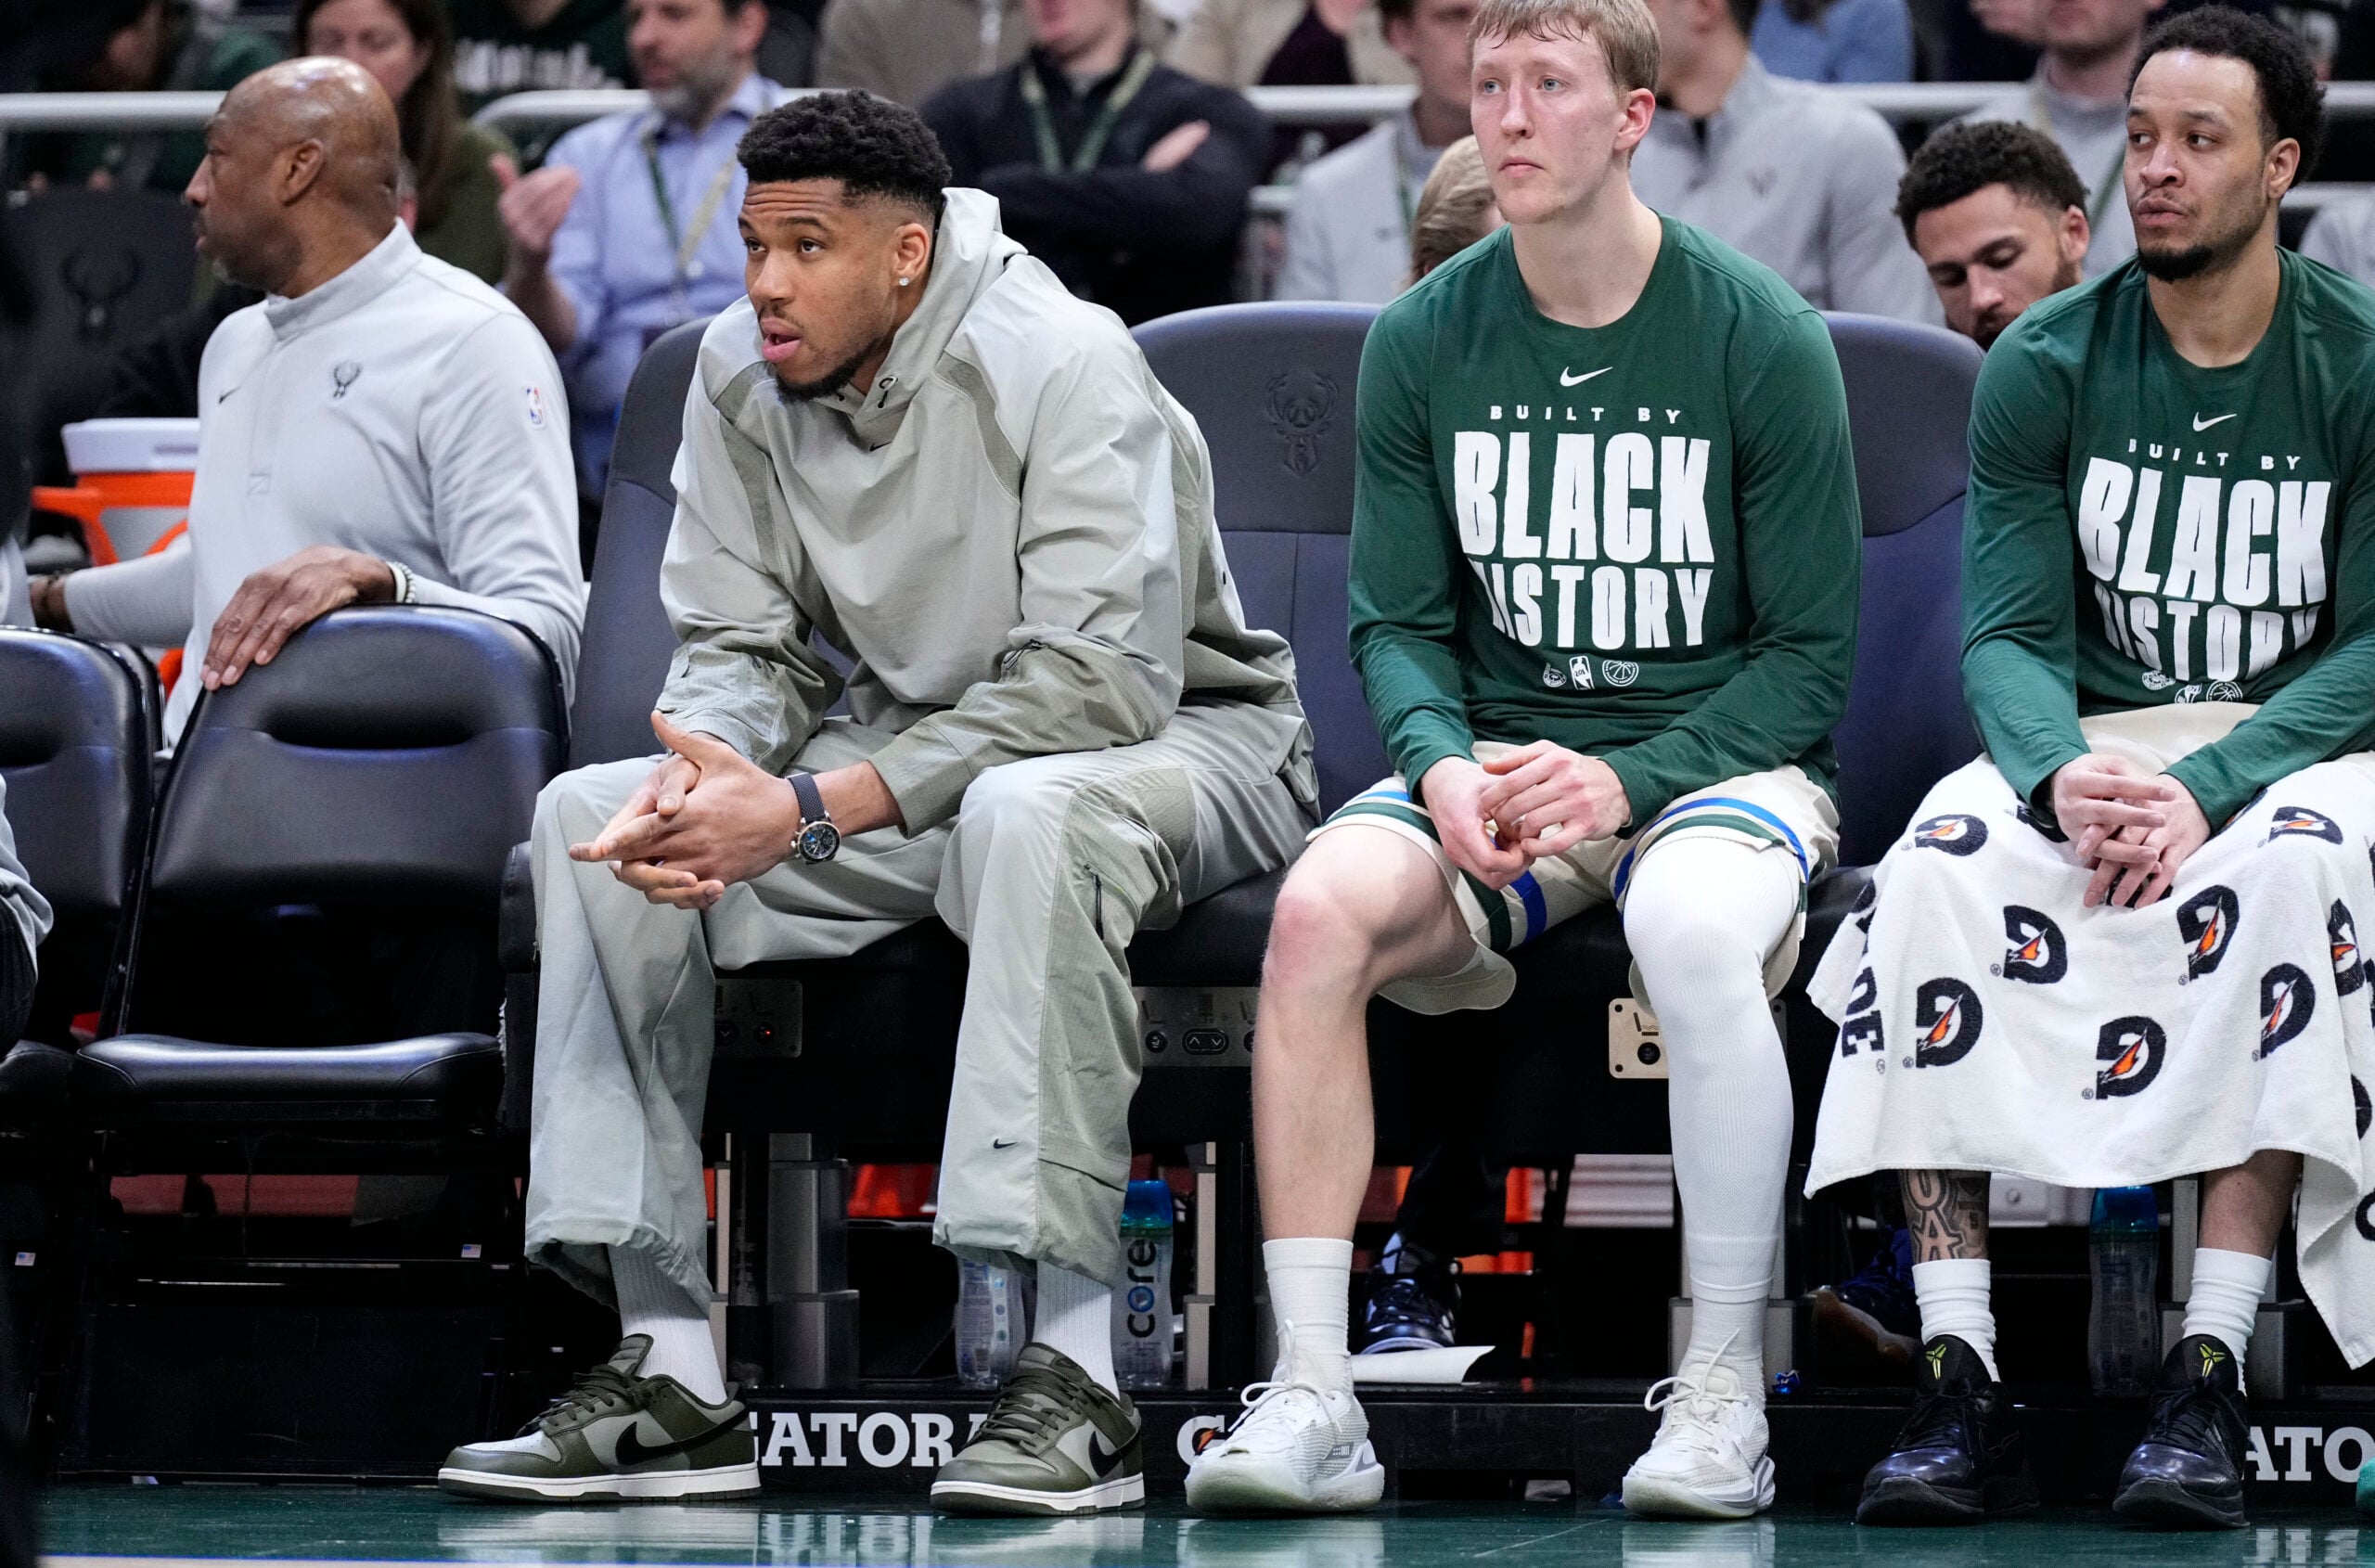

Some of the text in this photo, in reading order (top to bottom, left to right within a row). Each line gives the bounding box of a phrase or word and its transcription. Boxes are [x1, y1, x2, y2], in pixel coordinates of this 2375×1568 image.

[1490, 405, 1681, 424] BUILT BY
[2128, 438, 2301, 469] BUILT BY
[1454, 431, 1715, 563] BLACK
[2078, 456, 2331, 607] BLACK
[1127, 1239, 1156, 1338] core
[749, 1411, 988, 1468] ATOR
